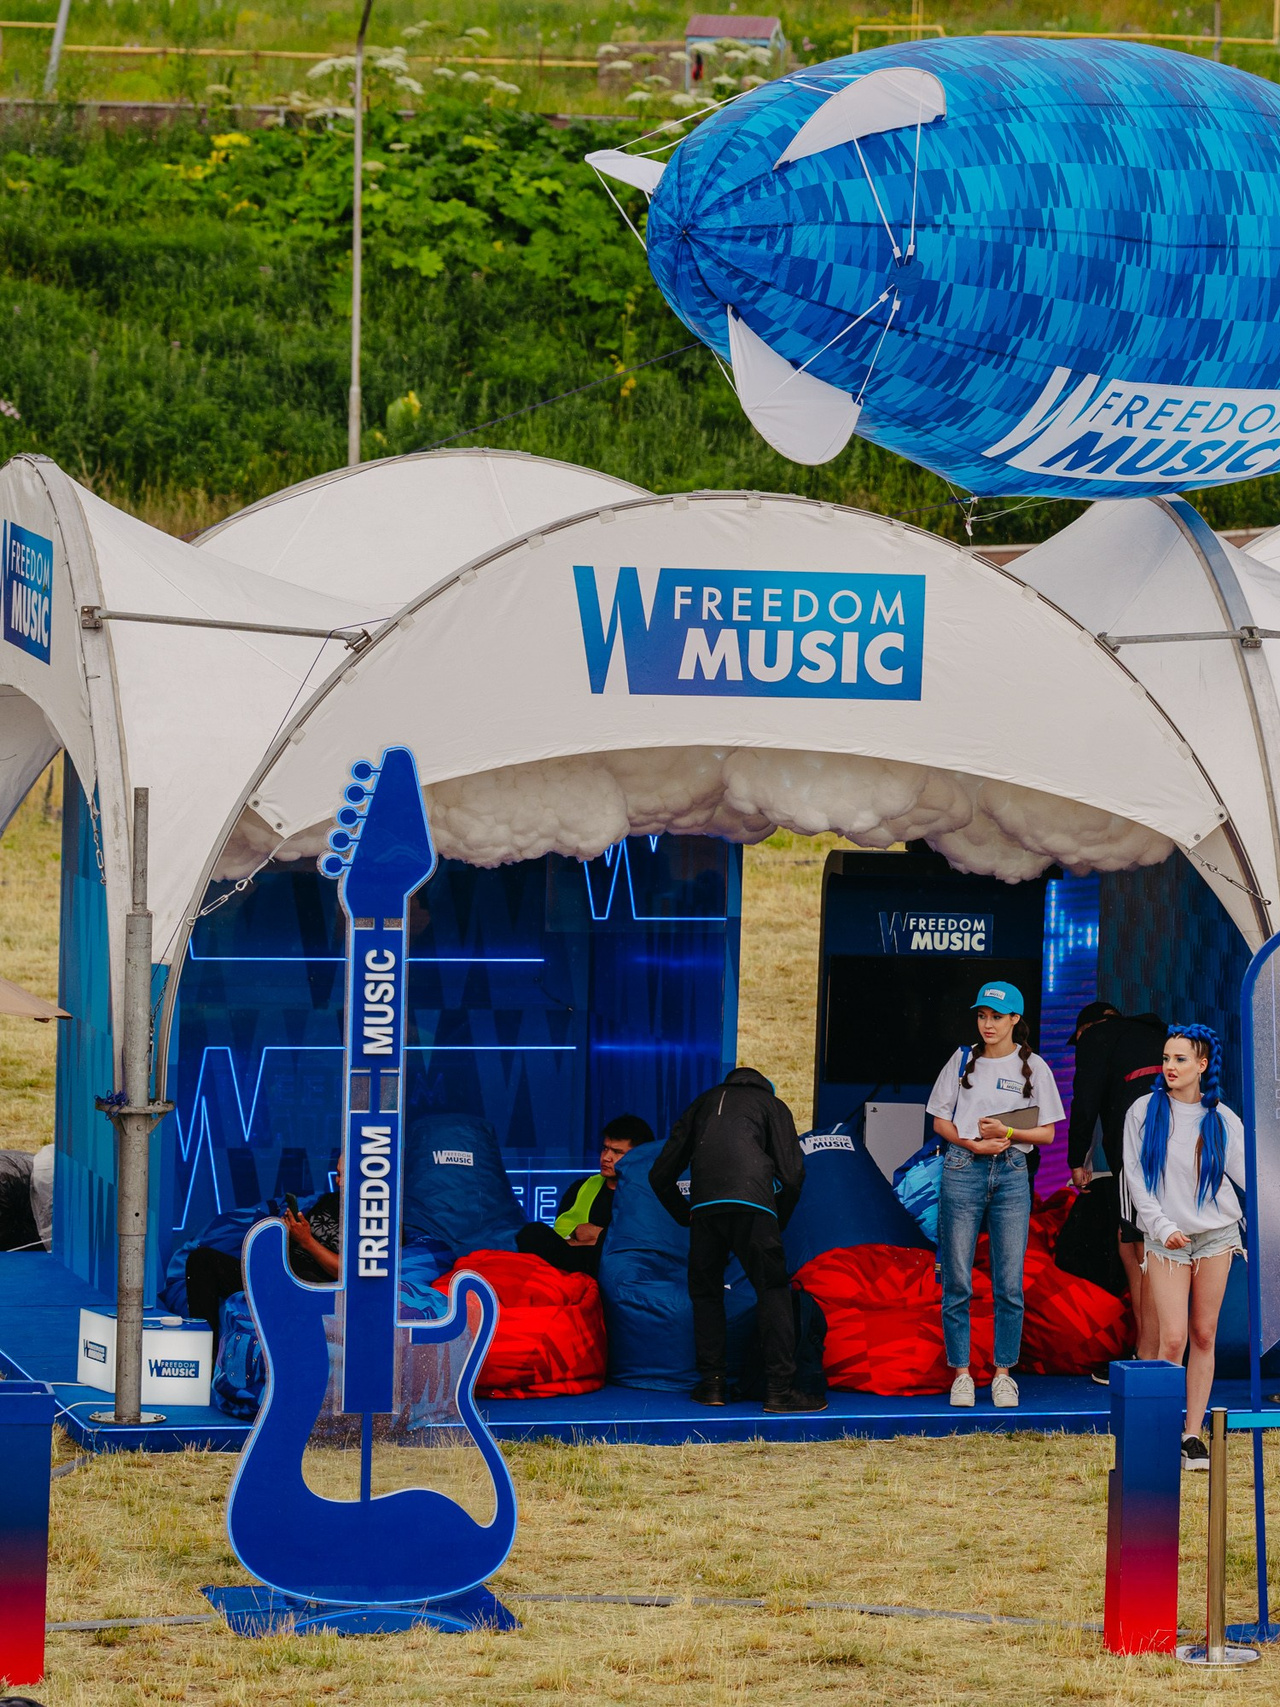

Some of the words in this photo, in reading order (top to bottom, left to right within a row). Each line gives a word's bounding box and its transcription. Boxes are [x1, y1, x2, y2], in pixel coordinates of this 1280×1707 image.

[11, 539, 50, 590] FREEDOM
[11, 580, 50, 648] MUSIC
[674, 586, 905, 626] FREEDOM
[677, 627, 905, 686] MUSIC
[909, 918, 986, 932] FREEDOM
[910, 931, 986, 952] MUSIC
[363, 949, 396, 1055] MUSIC
[445, 1156, 472, 1164] MUSIC
[813, 1141, 852, 1150] MUSIC
[358, 1126, 392, 1277] FREEDOM
[161, 1368, 195, 1377] MUSIC
